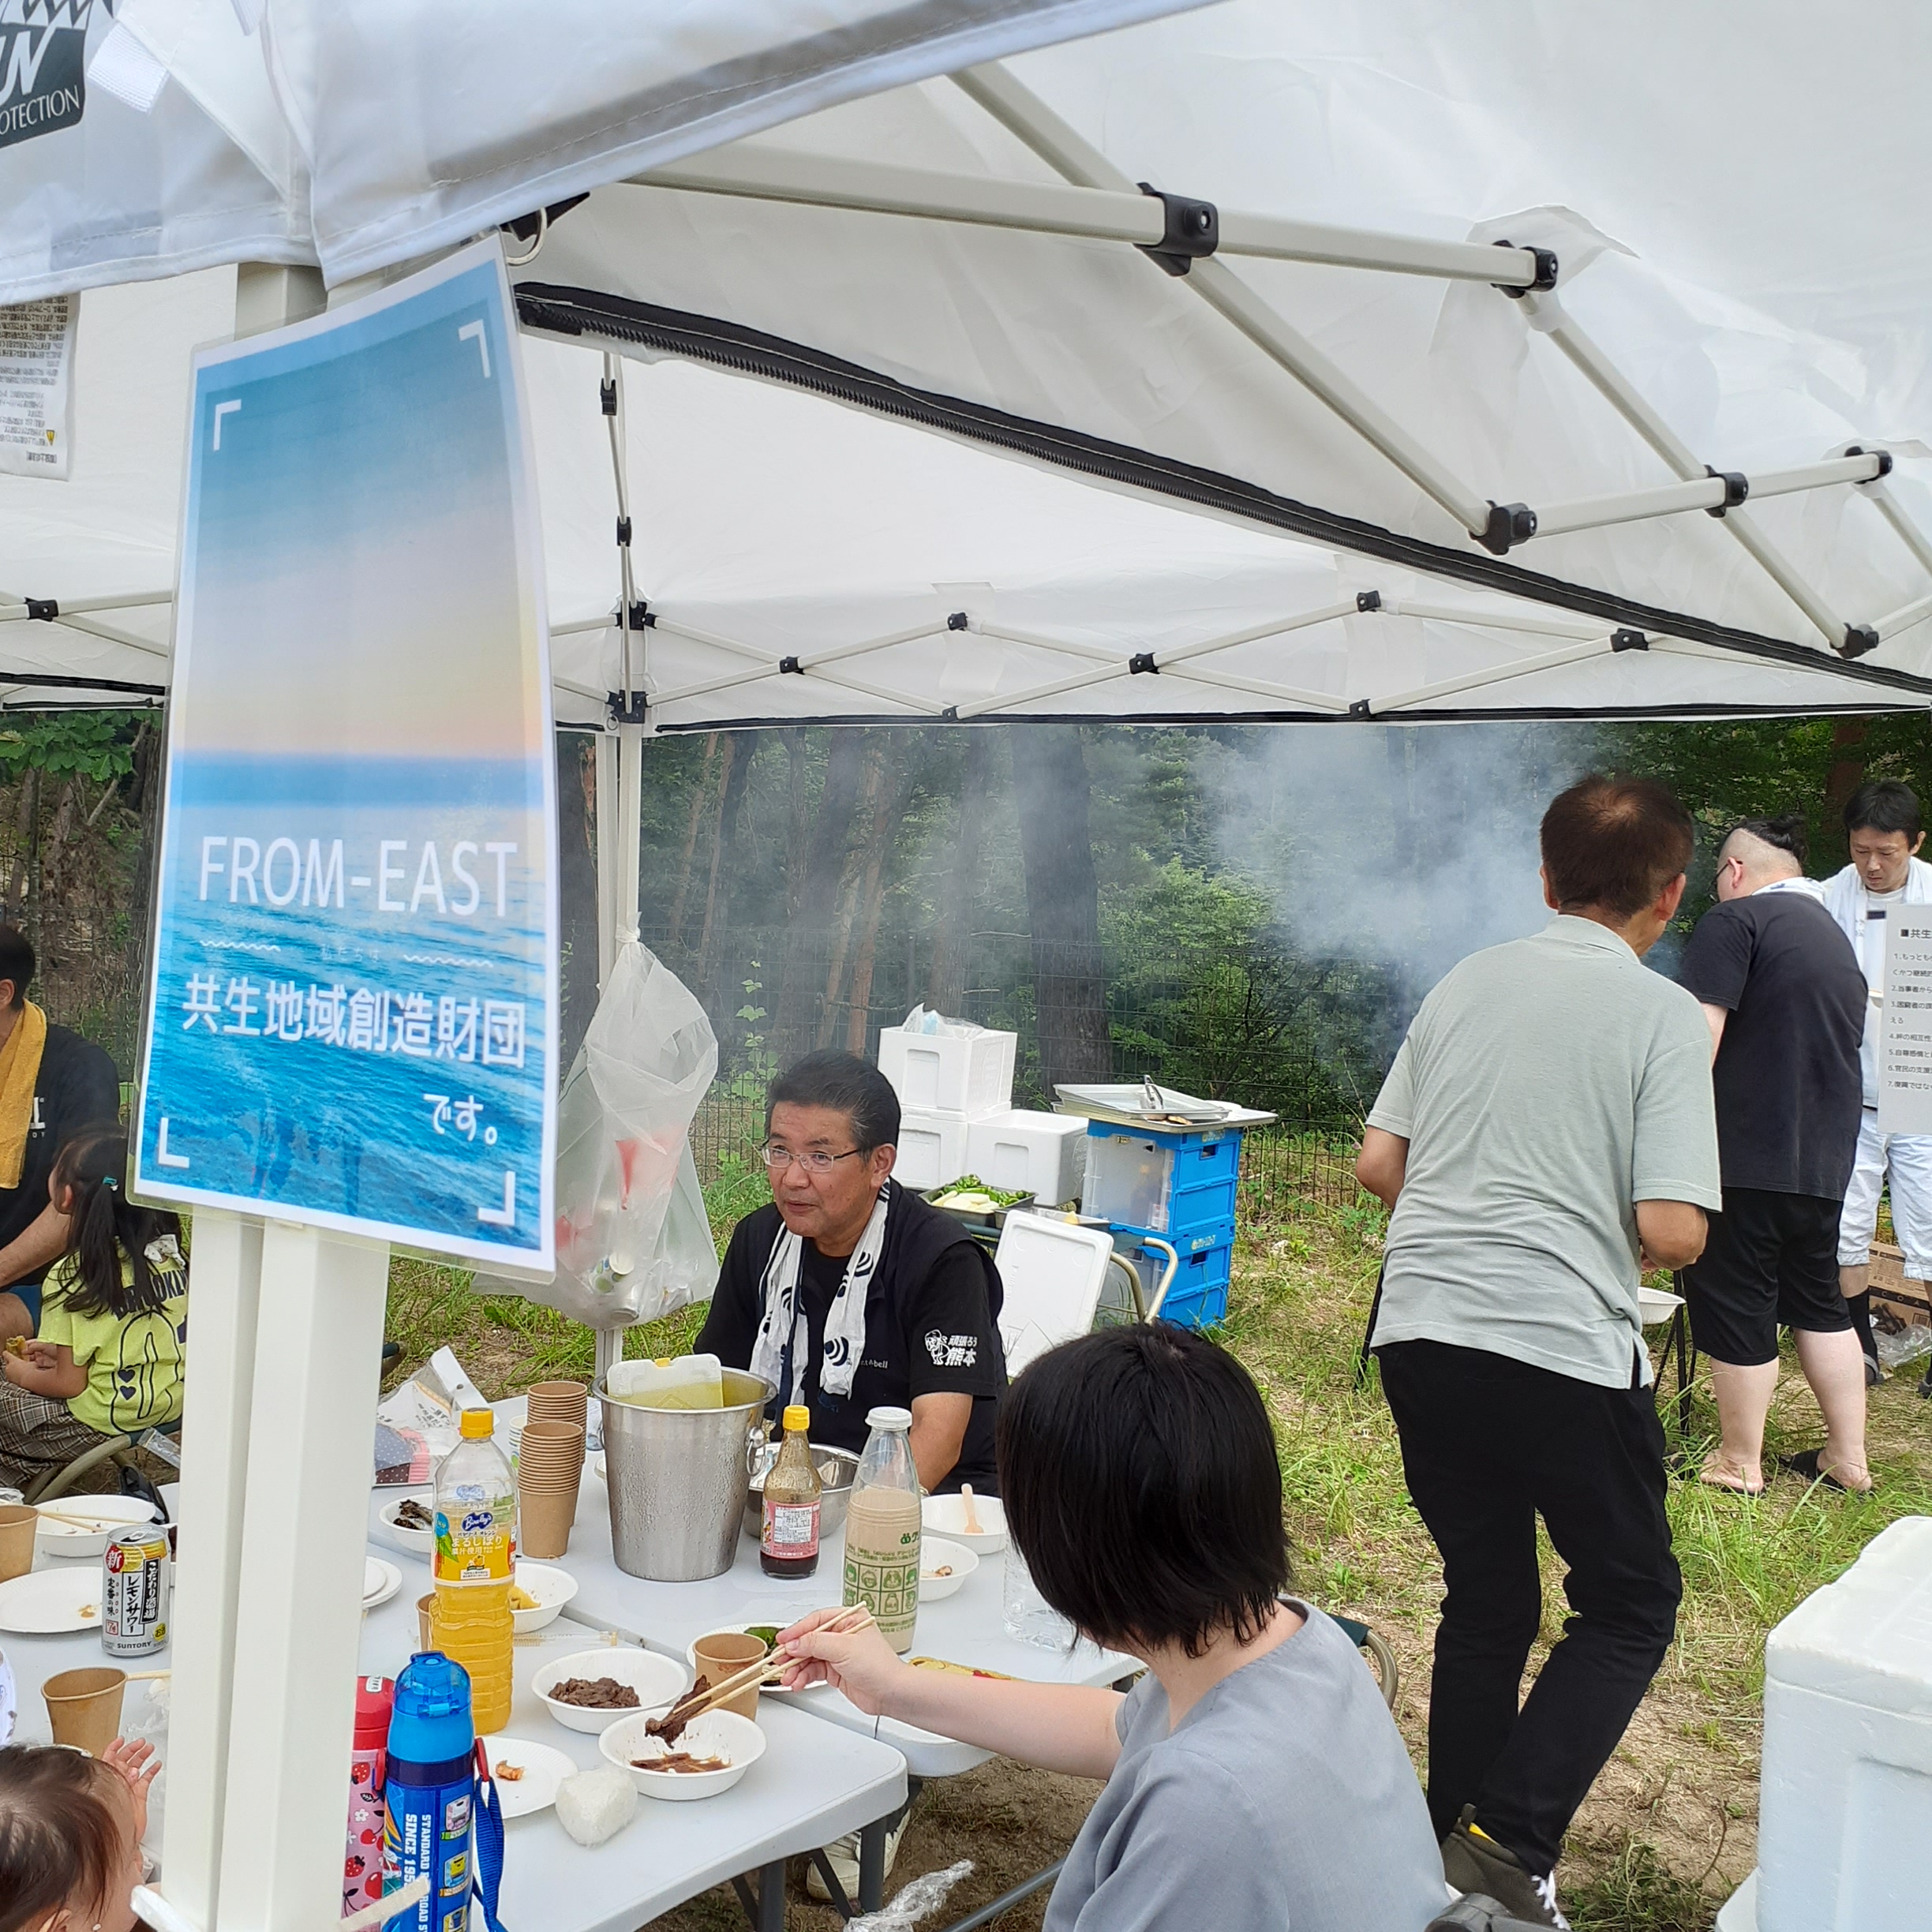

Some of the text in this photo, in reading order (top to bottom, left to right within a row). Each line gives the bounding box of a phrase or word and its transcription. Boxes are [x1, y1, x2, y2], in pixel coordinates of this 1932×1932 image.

[199, 836, 518, 917] FROM-EAST
[320, 943, 380, 963] 私たちは
[182, 973, 526, 1069] 共生地域創造財団
[1888, 1049, 1932, 1058] 5.自尊感情と
[1887, 1065, 1932, 1074] 6.官民の支援
[1887, 1080, 1932, 1090] 7.復興ではな
[423, 1094, 498, 1146] です。
[948, 1335, 978, 1347] 頑張ろう
[945, 1347, 977, 1367] 熊本
[451, 1535, 503, 1547] まるしぼり
[107, 1550, 122, 1569] 新
[107, 1577, 116, 1617] 定番の味
[125, 1575, 141, 1634] レモンサワー
[117, 1641, 152, 1649] SUNTORY
[403, 1814, 417, 1887] SINCE 195
[420, 1814, 432, 1870] STANDARD
